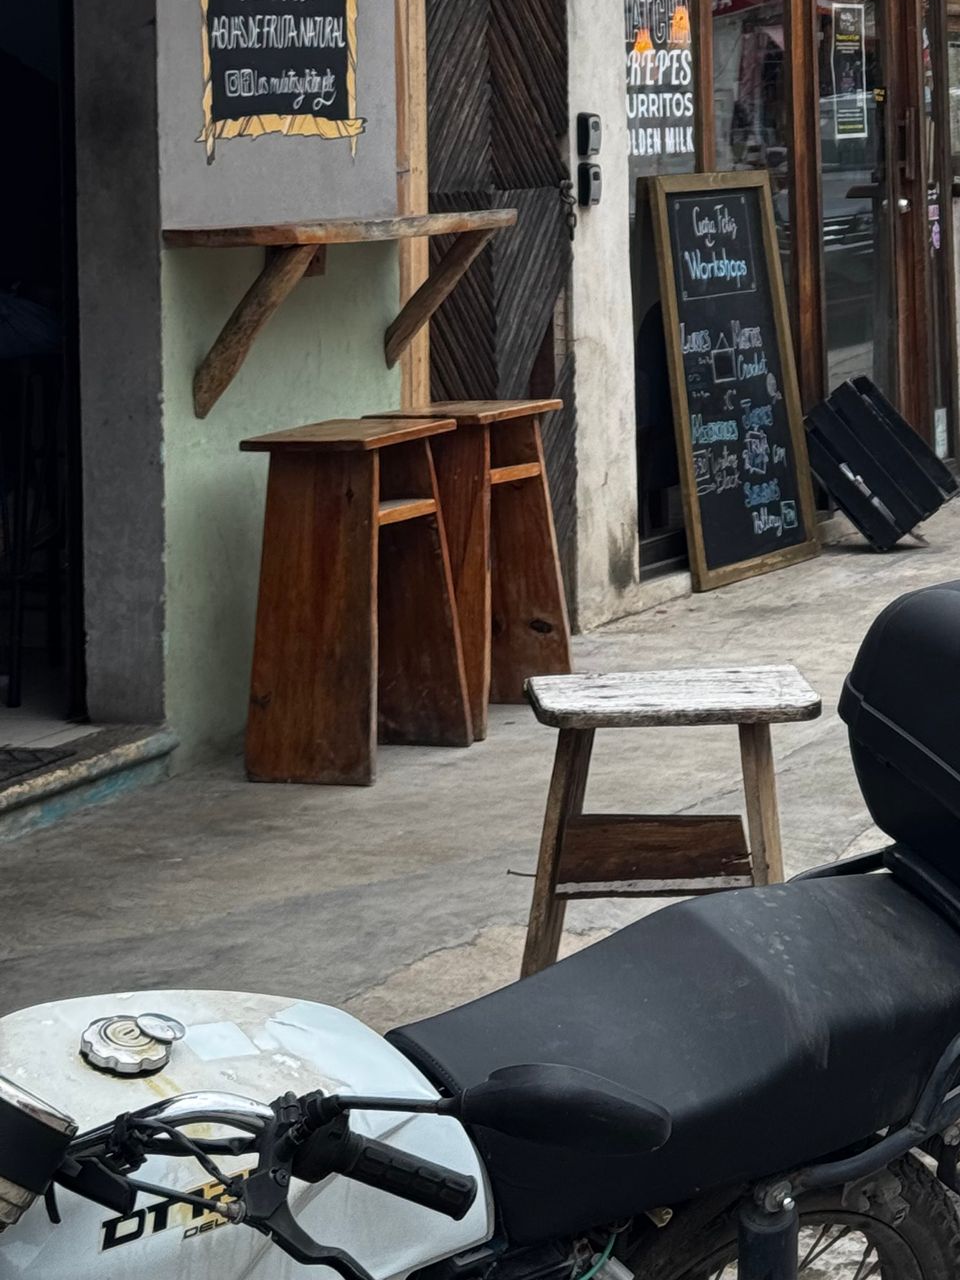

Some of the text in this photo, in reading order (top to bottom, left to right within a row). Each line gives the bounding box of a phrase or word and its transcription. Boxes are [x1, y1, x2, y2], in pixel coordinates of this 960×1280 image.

[248, 15, 262, 49] DE
[262, 14, 299, 49] FRUTA
[299, 15, 346, 49] NATURAL
[626, 49, 692, 86] REPES
[626, 92, 694, 119] URRITOS
[627, 126, 695, 156] OLDEN MILK
[684, 247, 748, 288] Workshops
